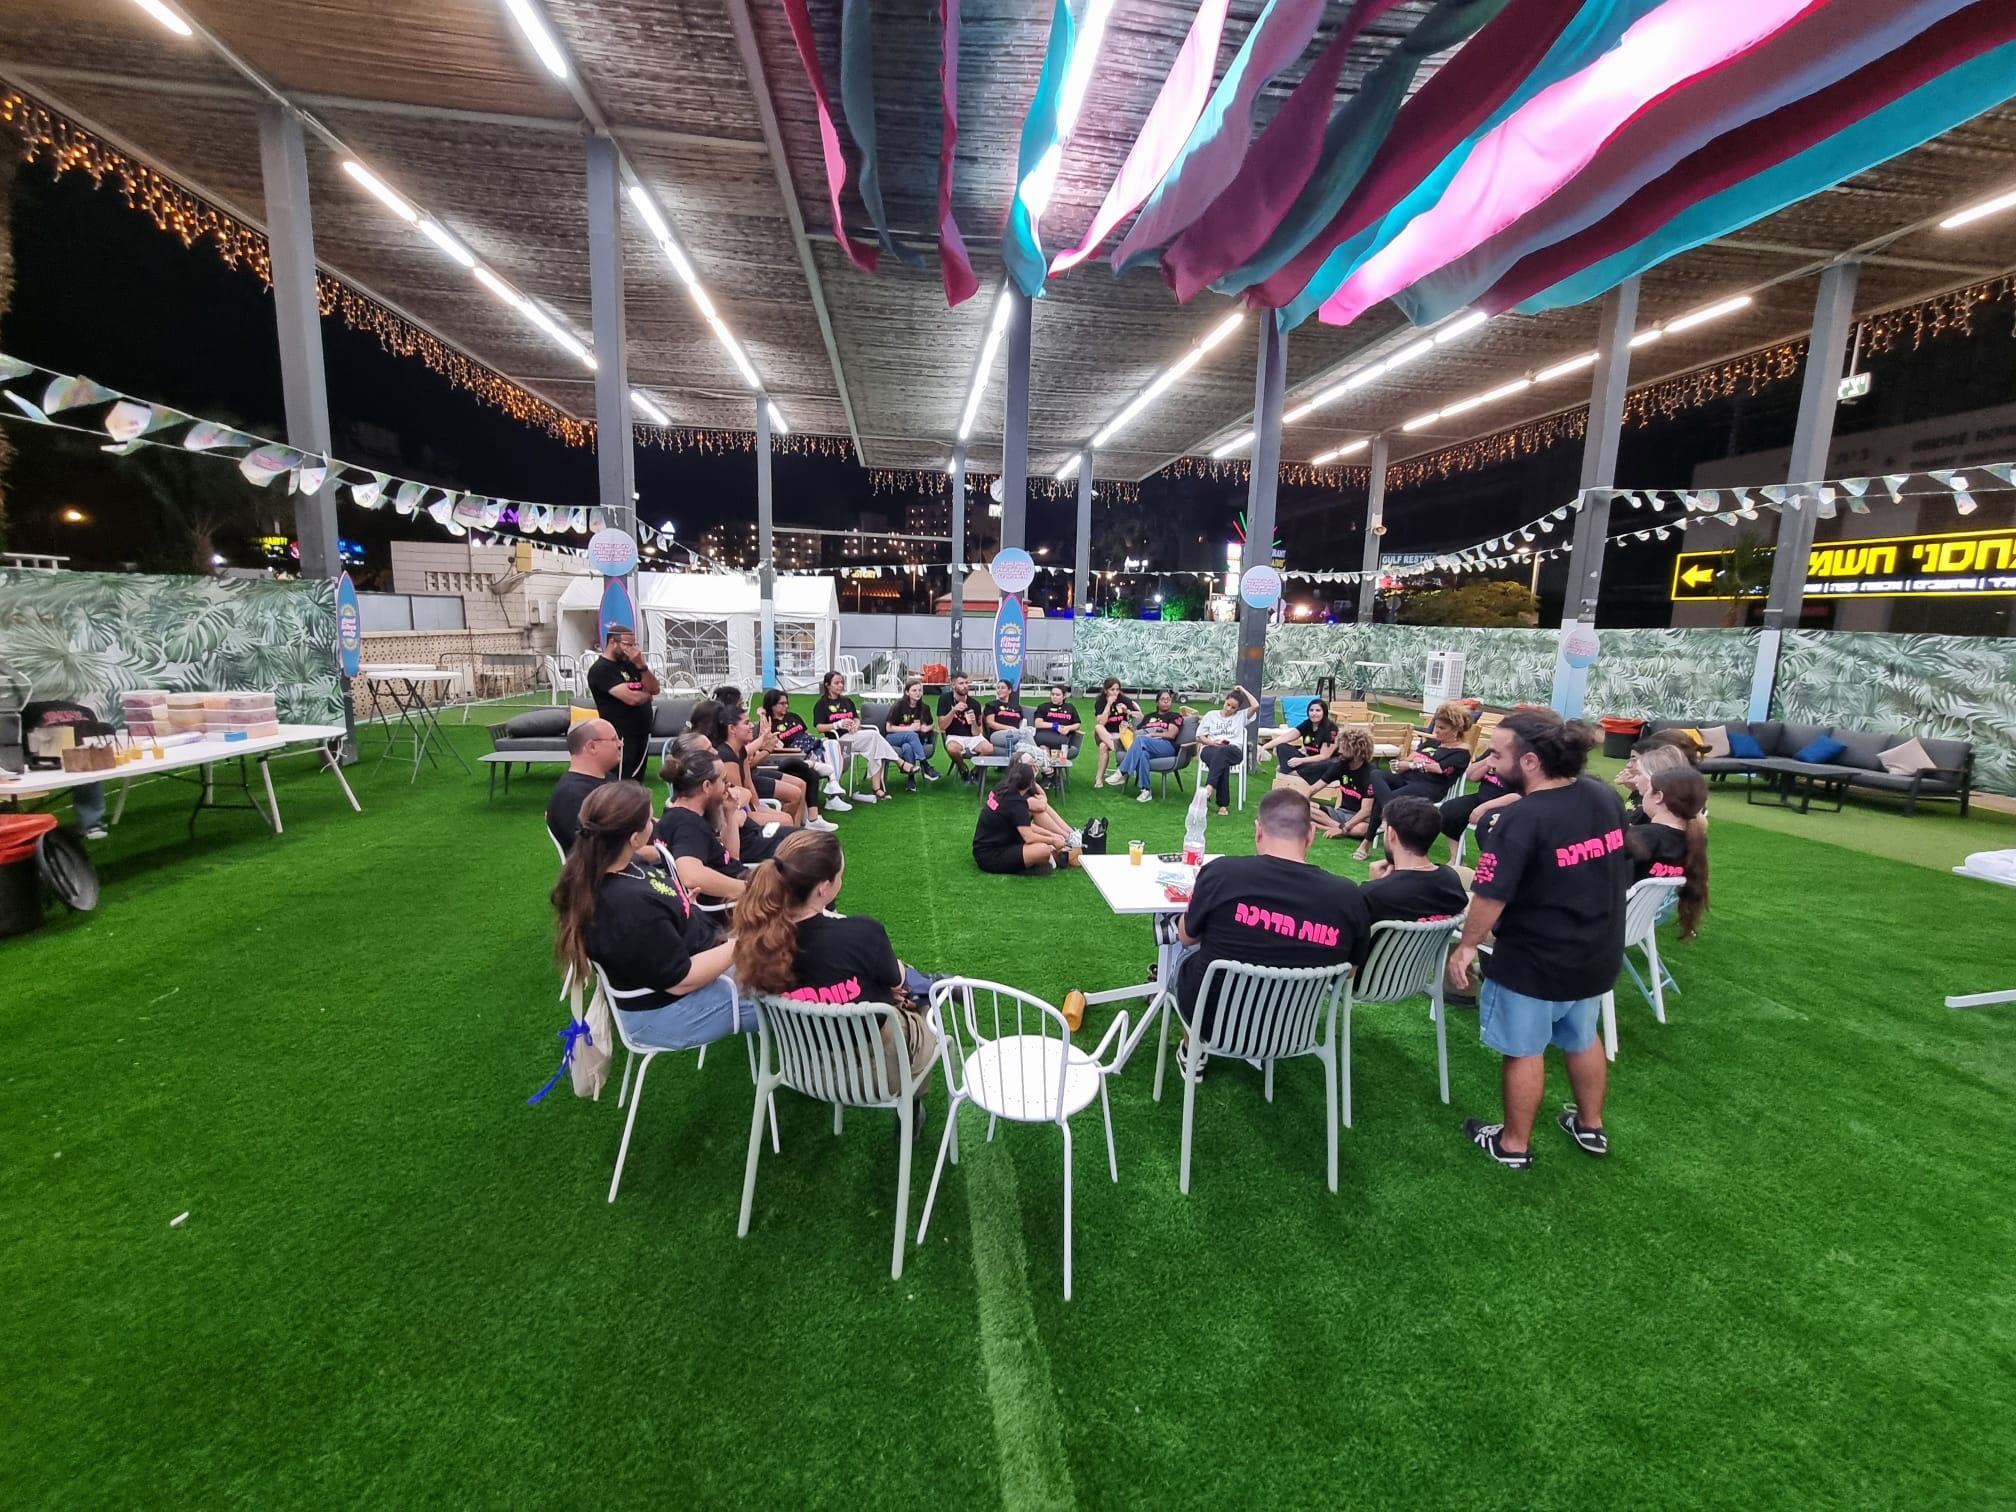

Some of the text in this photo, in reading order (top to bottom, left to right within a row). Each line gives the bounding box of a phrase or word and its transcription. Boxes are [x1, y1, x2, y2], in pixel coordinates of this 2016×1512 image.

[1382, 555, 1402, 564] GULF
[1808, 546, 1898, 576] חשמ
[1001, 647, 1019, 655] only
[1234, 902, 1340, 947] צוות הדרכה
